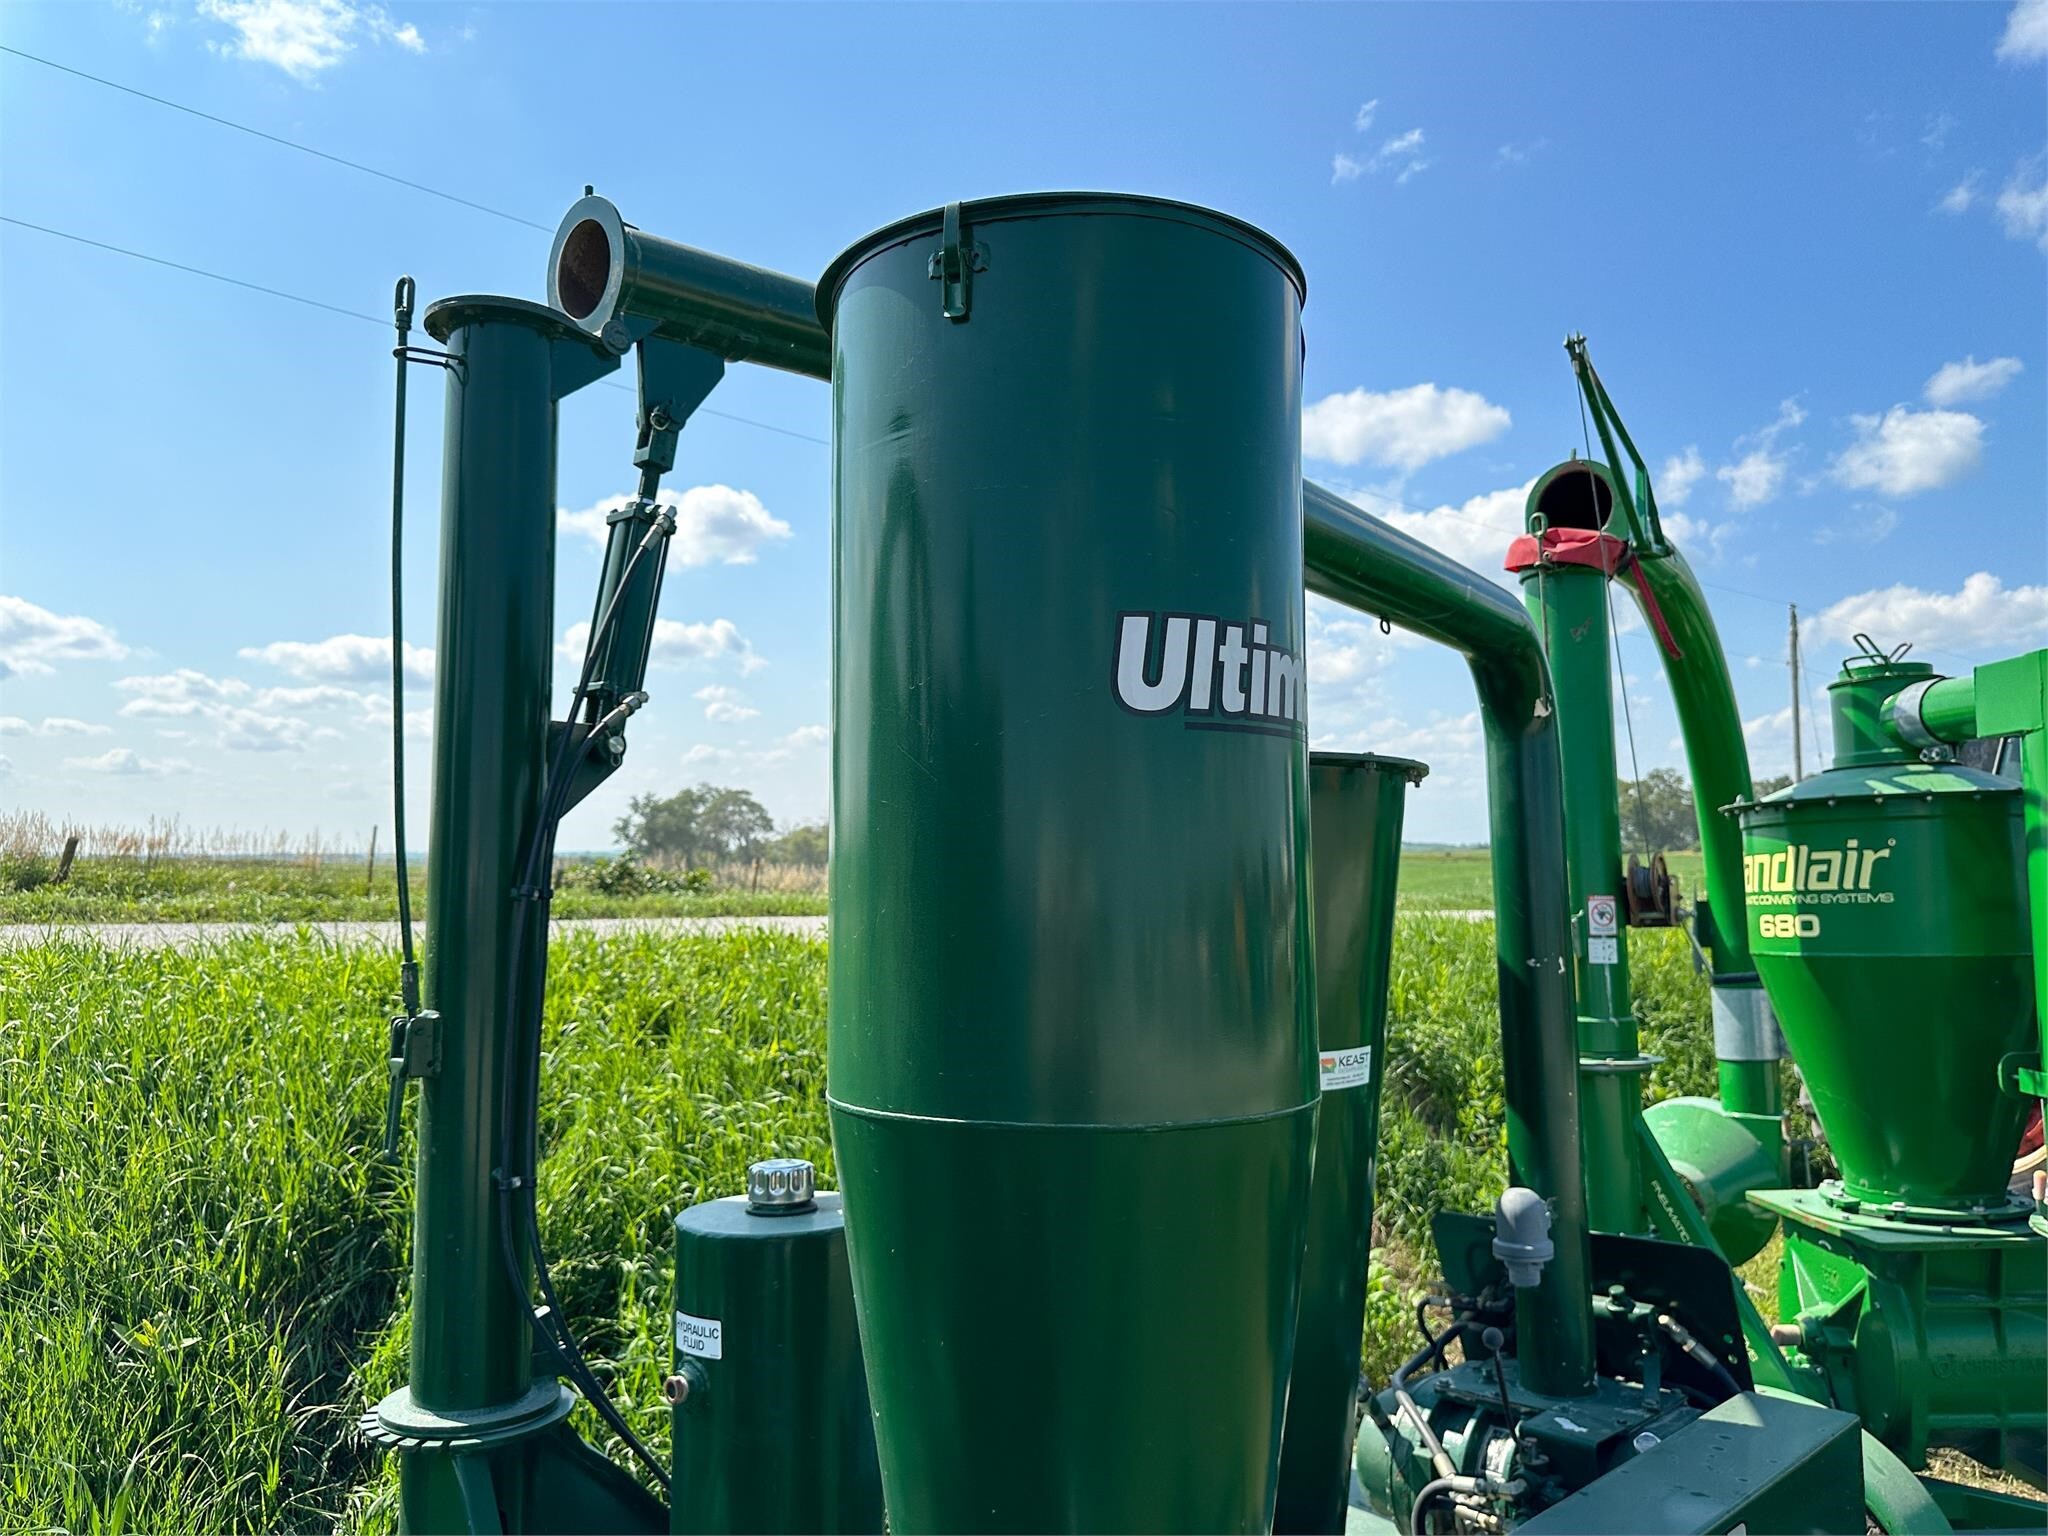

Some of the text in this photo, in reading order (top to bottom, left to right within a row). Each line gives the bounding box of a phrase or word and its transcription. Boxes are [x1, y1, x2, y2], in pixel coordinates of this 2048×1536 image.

[1820, 892, 1895, 904] SYSTEMS
[1759, 914, 1820, 938] 680
[1338, 1052, 1370, 1067] KEAST
[683, 1335, 705, 1351] FLUID
